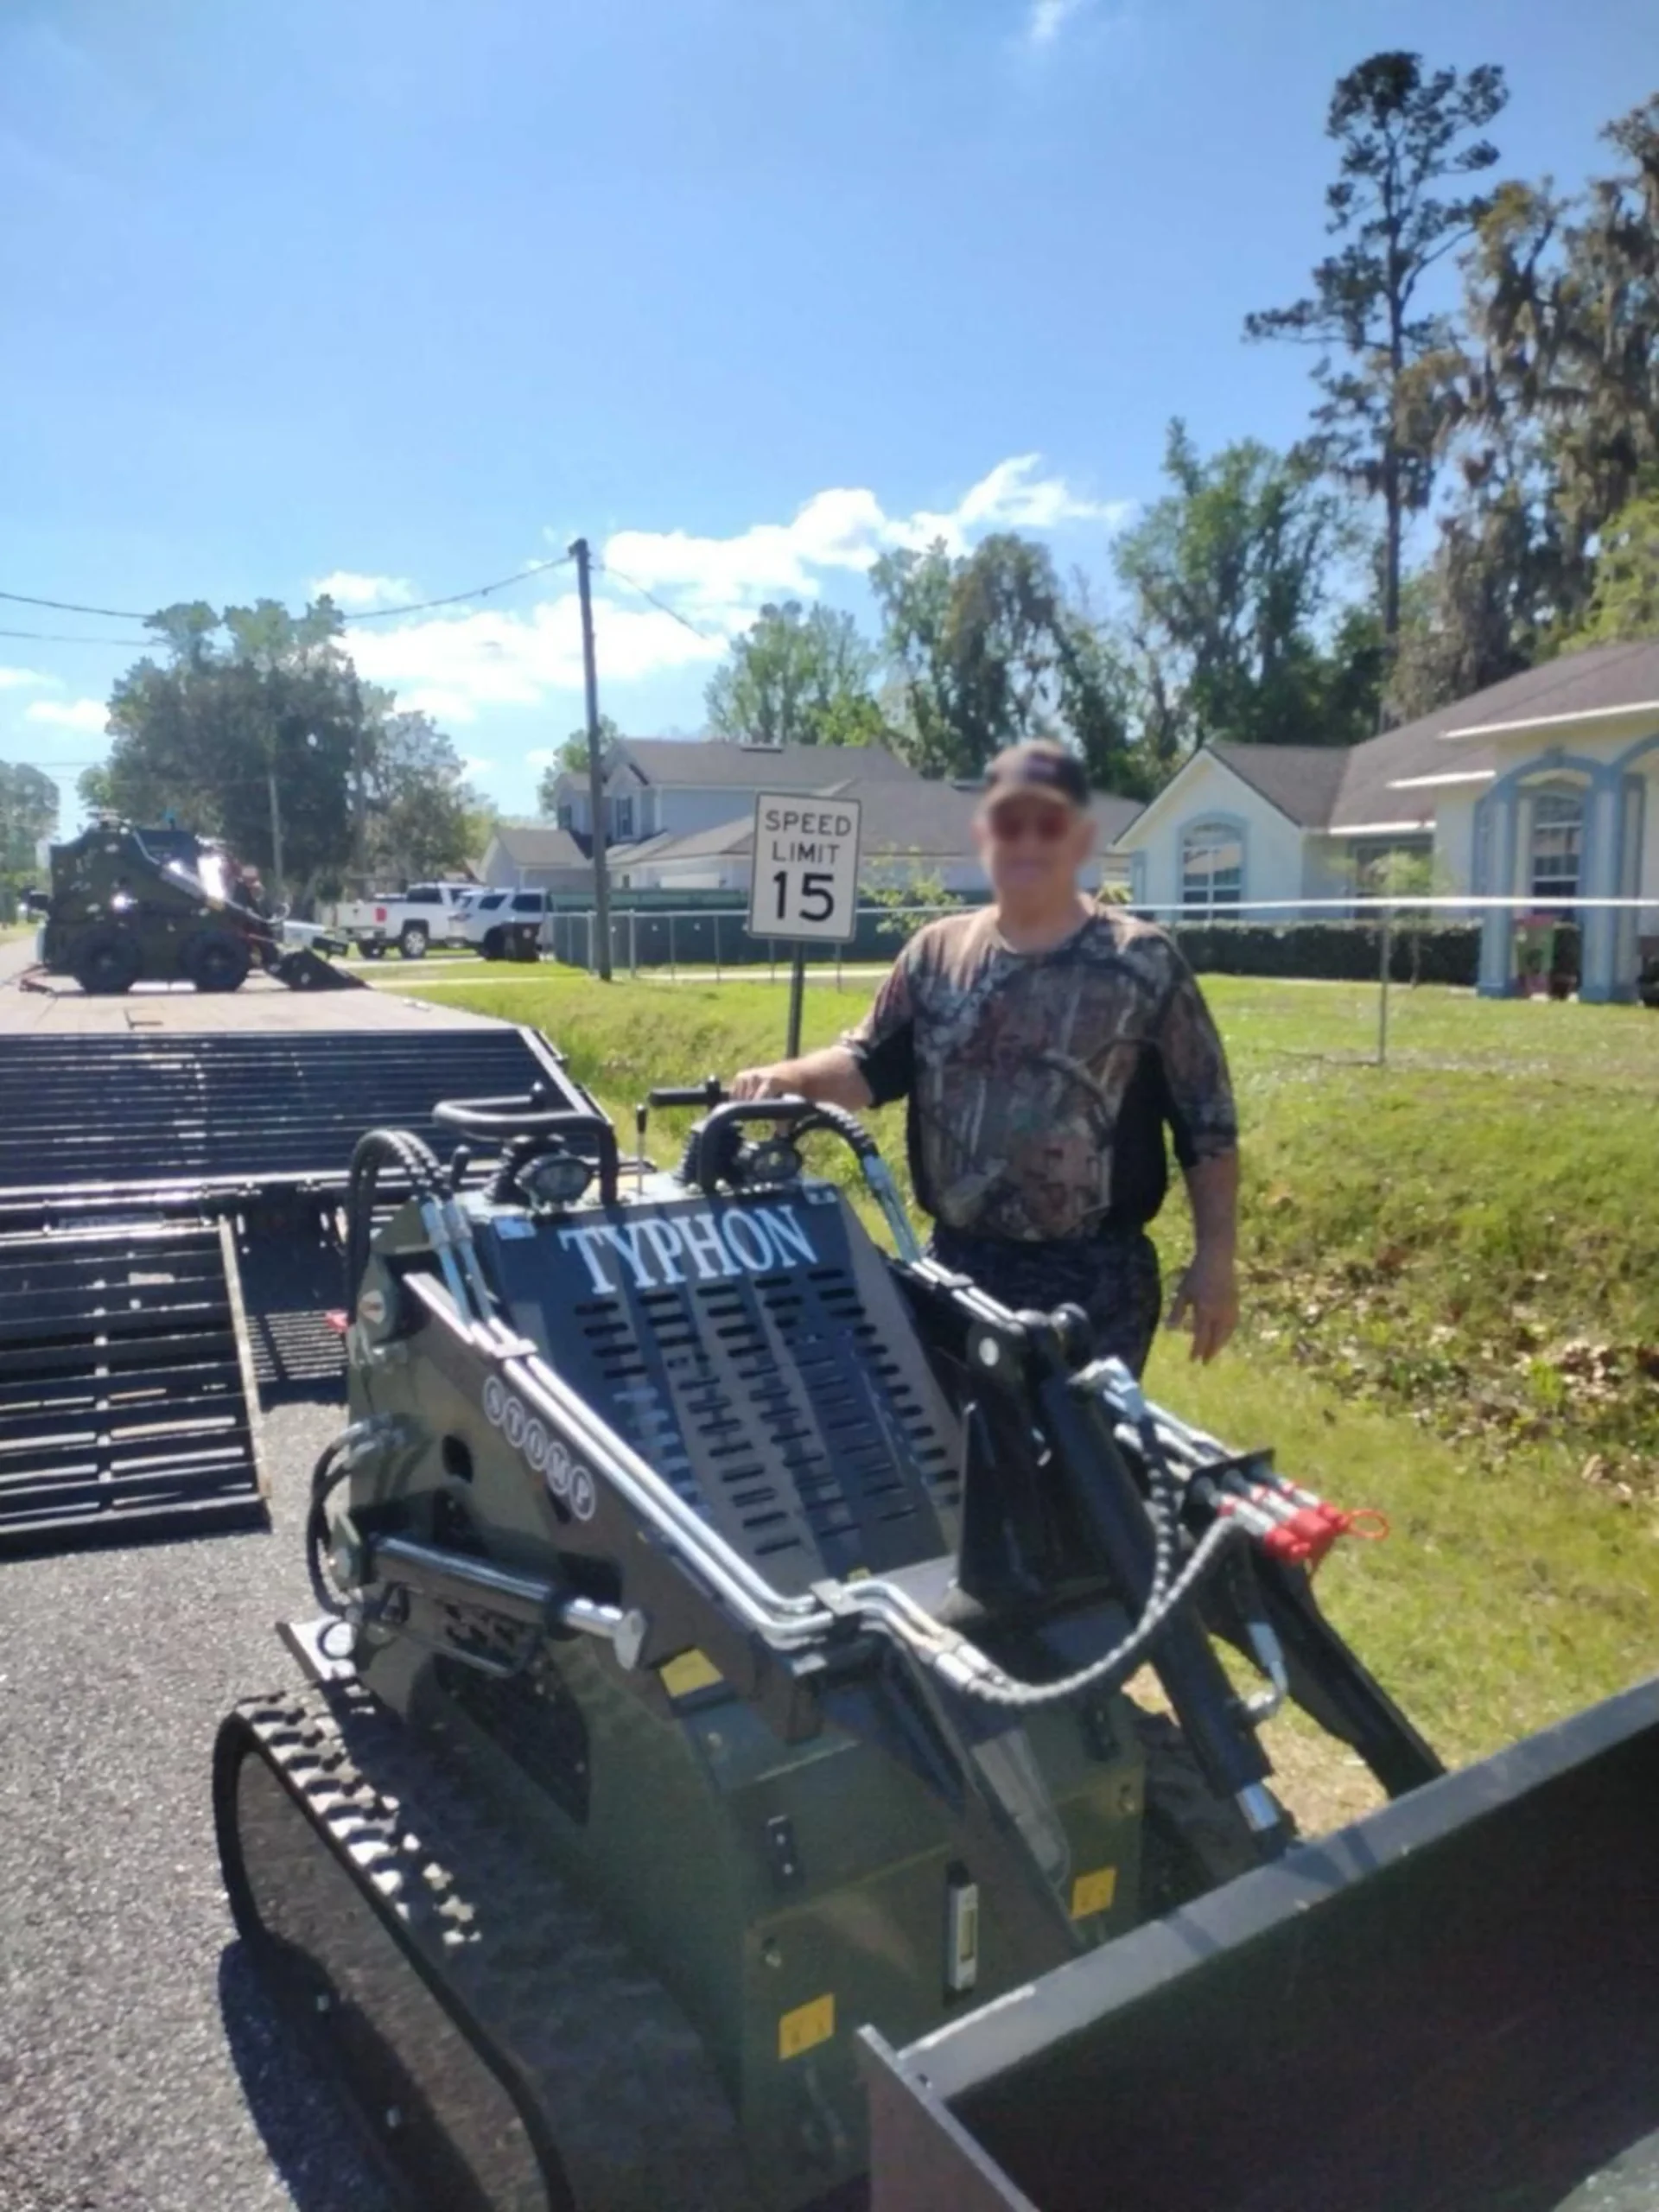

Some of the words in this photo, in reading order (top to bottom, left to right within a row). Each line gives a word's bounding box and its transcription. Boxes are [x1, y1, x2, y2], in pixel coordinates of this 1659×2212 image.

[766, 810, 852, 836] SPEED
[772, 841, 841, 864] LIMIT
[773, 870, 835, 922] 15
[557, 1205, 818, 1294] TYPHON
[485, 1380, 594, 1516] STOMP
